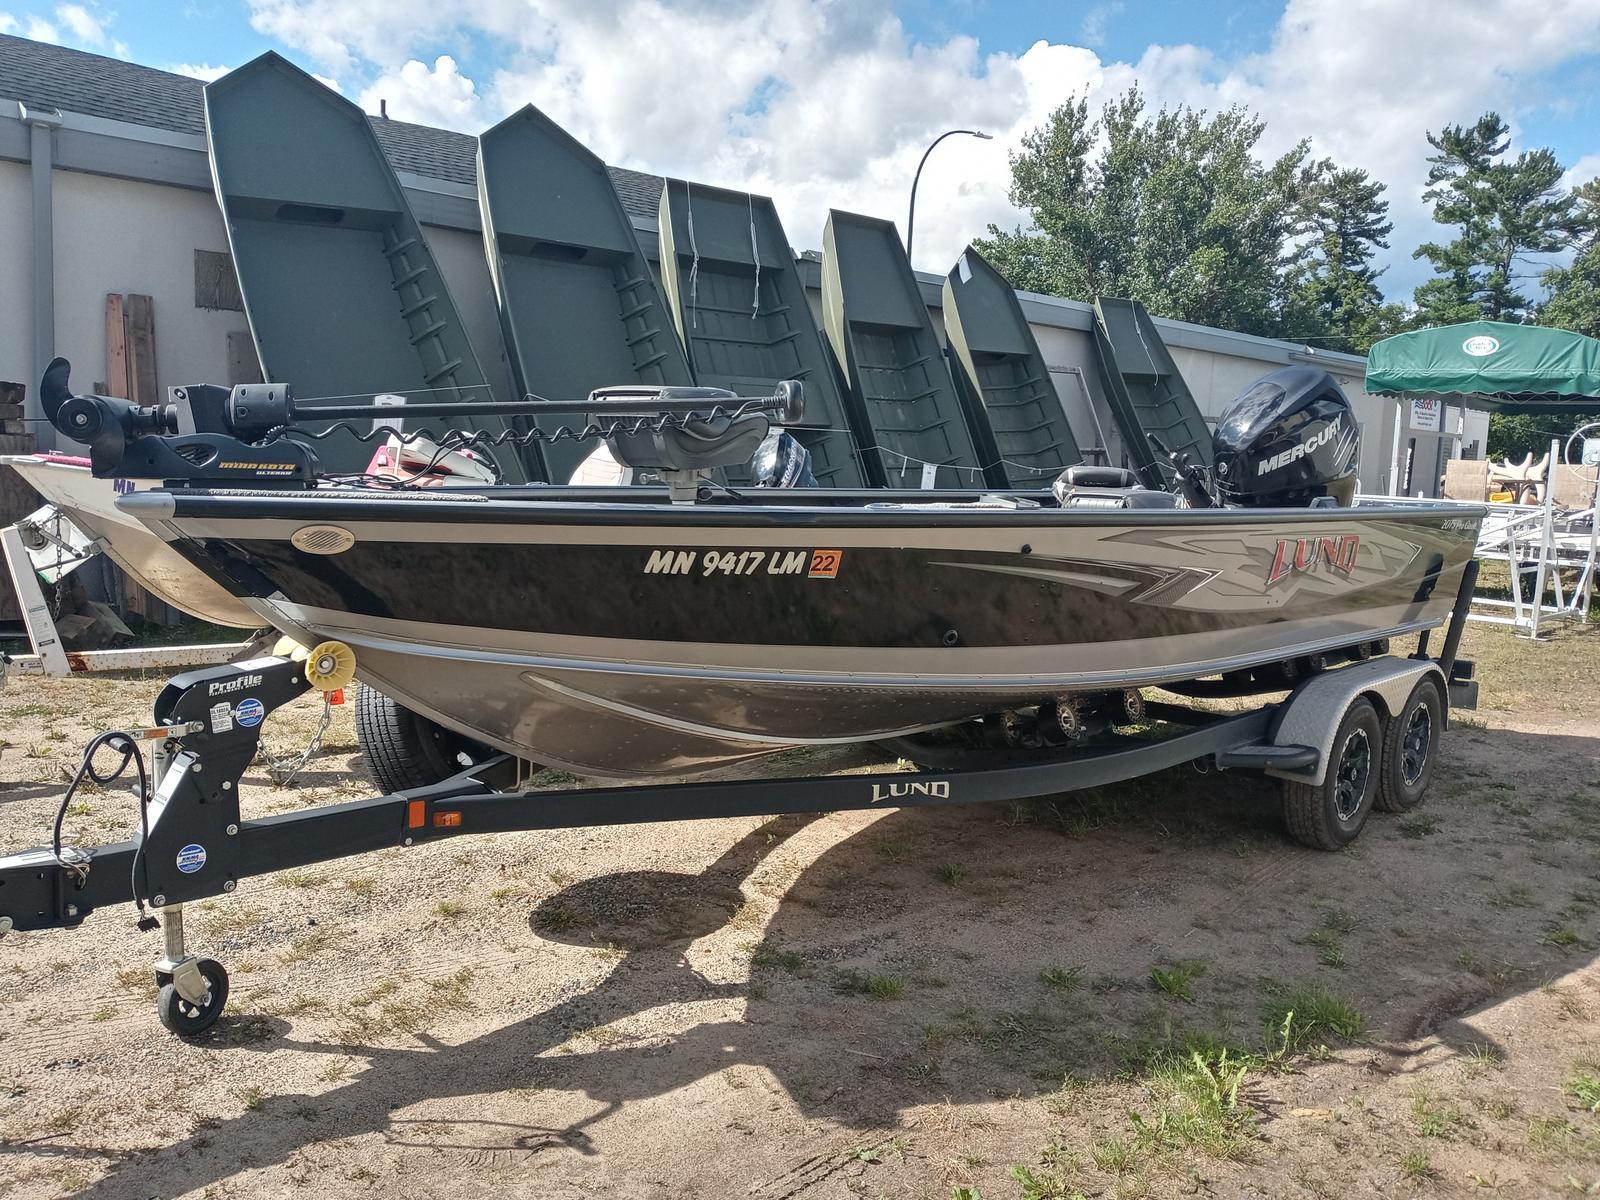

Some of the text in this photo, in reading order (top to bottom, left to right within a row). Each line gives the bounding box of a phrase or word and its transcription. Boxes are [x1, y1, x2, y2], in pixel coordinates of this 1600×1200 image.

[1257, 411, 1342, 476] MERCURY
[113, 478, 136, 495] MN
[643, 550, 807, 577] MN 9417 LM
[810, 555, 835, 572] 22
[1265, 535, 1360, 586] LUND
[208, 674, 263, 695] Profile
[871, 781, 950, 803] LUND
